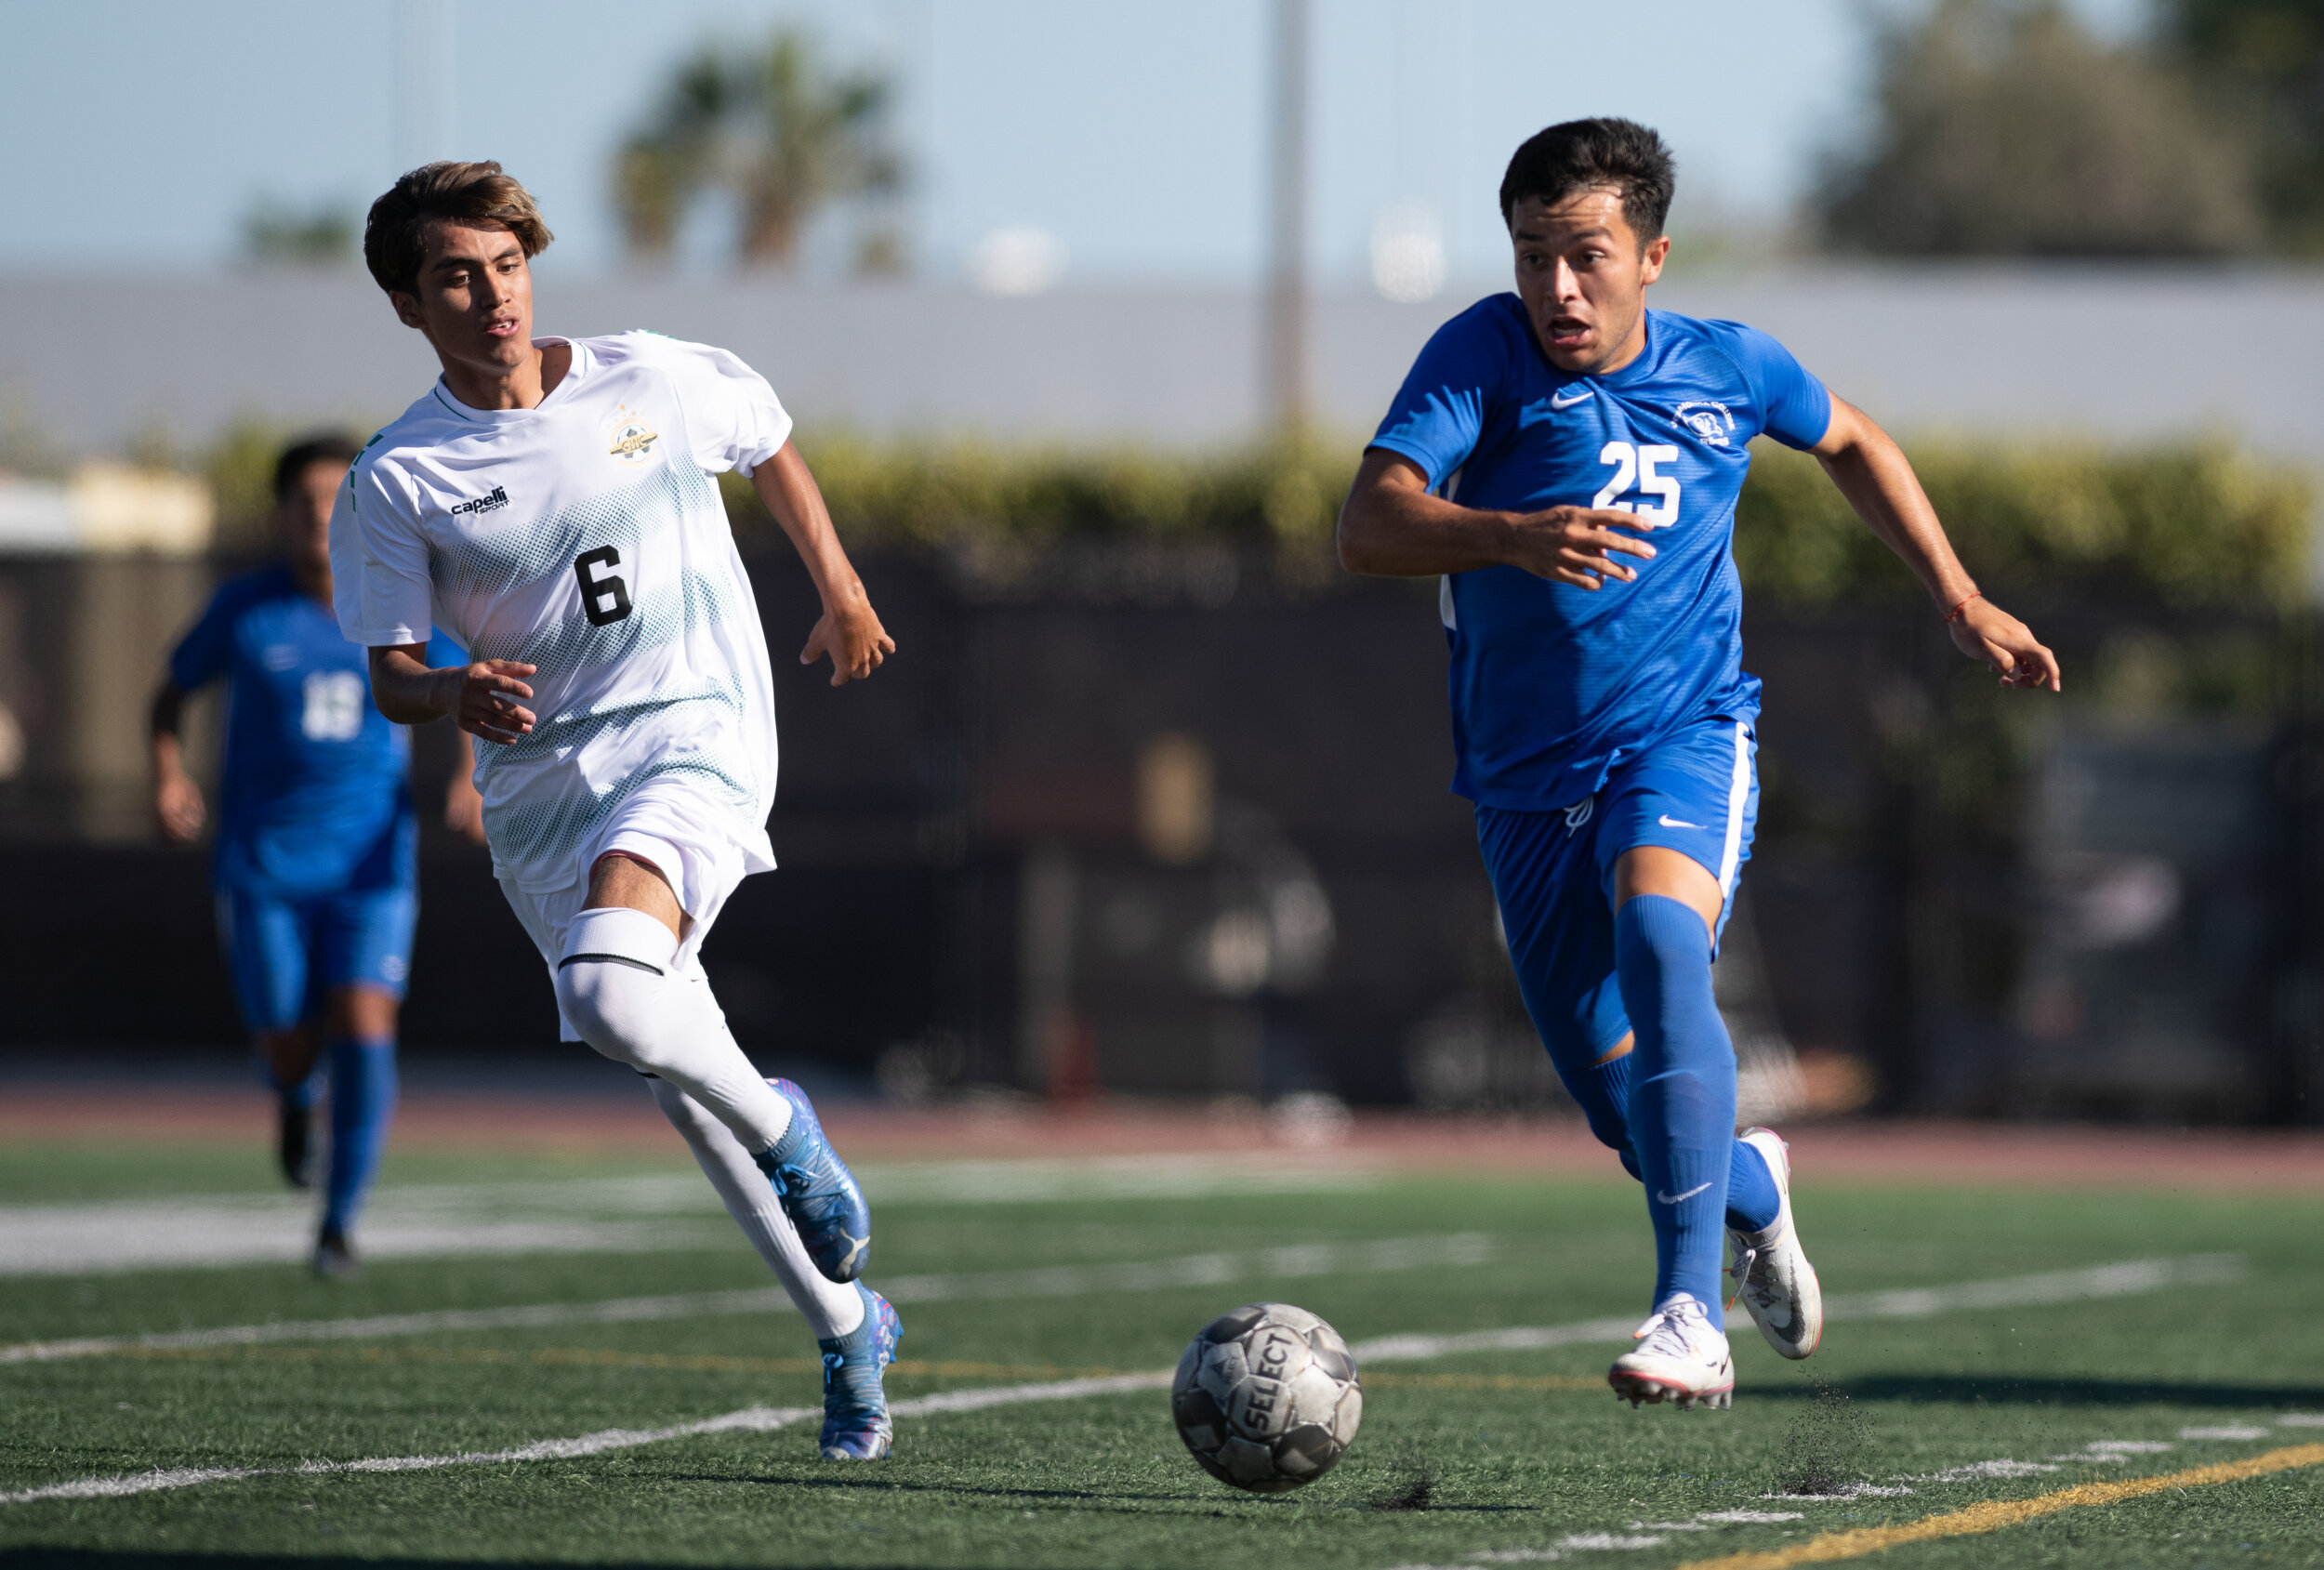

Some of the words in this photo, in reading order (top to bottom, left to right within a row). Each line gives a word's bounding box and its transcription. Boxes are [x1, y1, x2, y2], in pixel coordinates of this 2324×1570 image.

[622, 434, 647, 452] GWC
[451, 485, 508, 515] capelli
[479, 499, 510, 514] SPORT
[1592, 441, 1681, 528] 25
[574, 544, 633, 627] 6
[1244, 1332, 1293, 1431] SELECT
